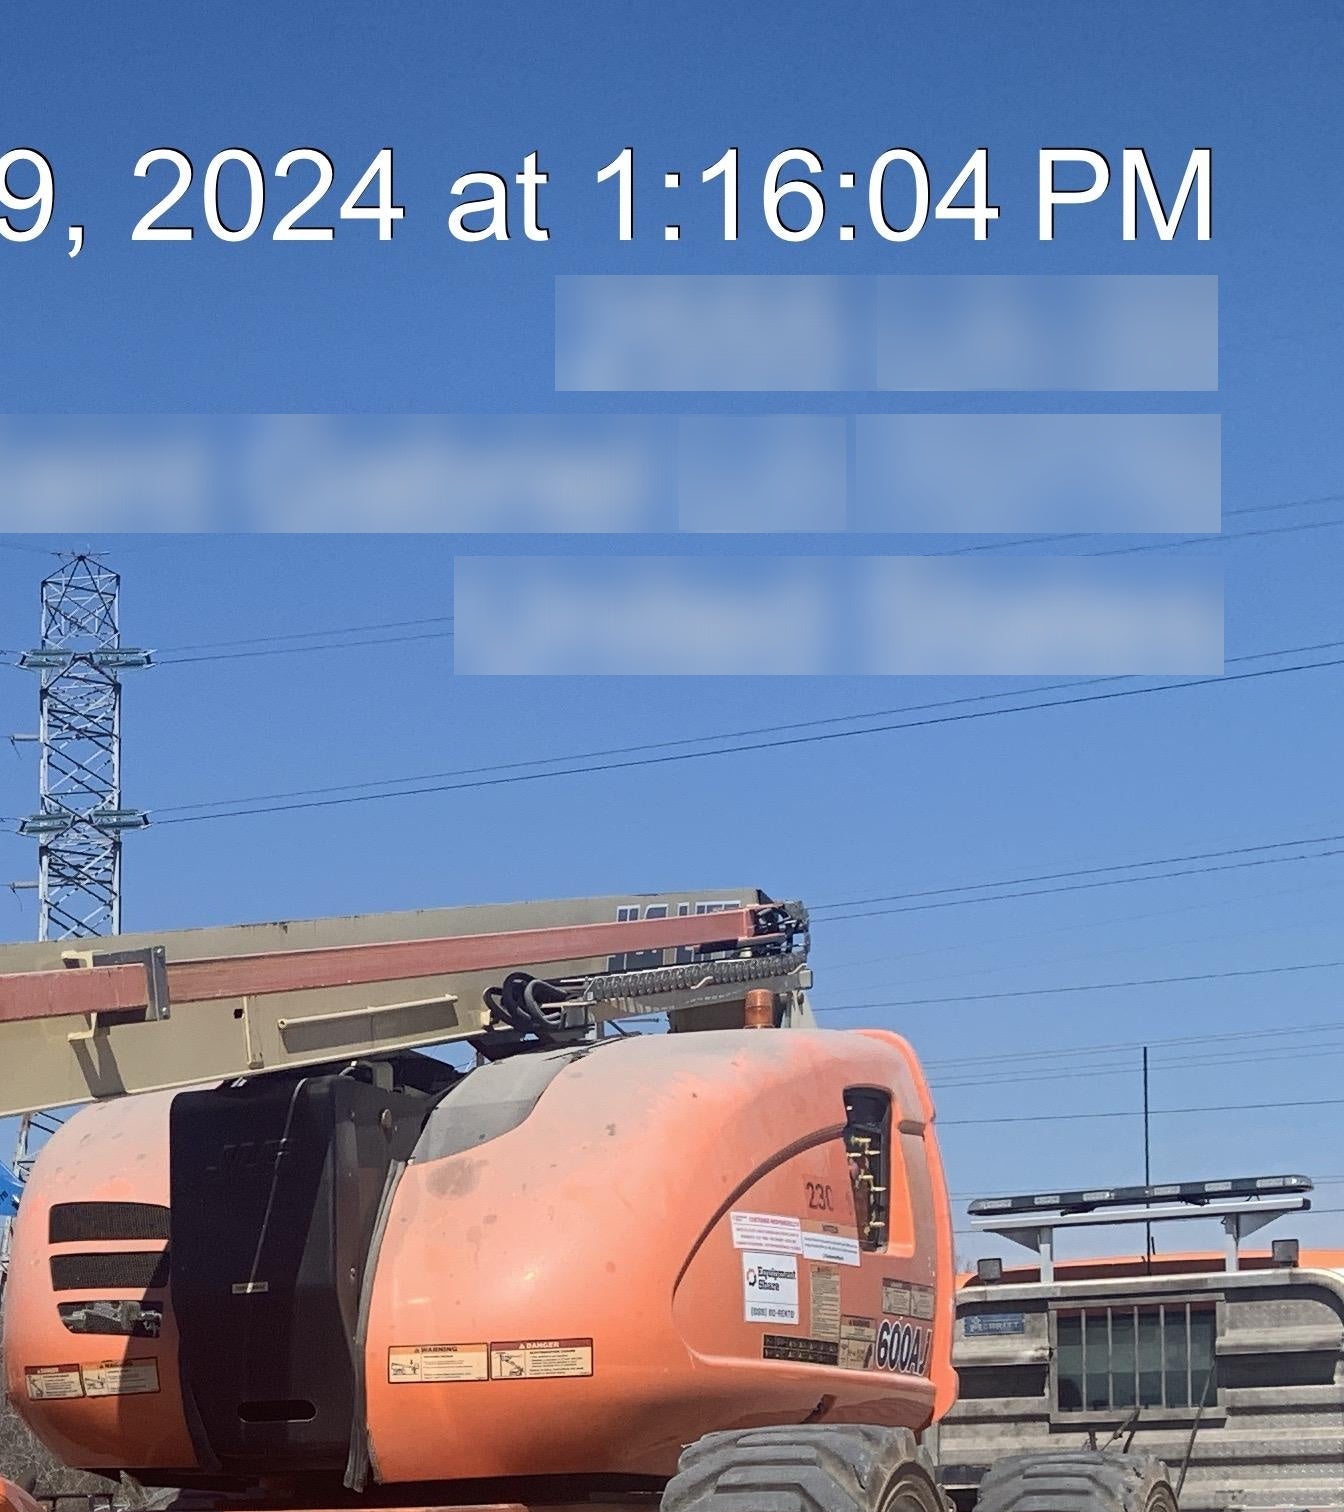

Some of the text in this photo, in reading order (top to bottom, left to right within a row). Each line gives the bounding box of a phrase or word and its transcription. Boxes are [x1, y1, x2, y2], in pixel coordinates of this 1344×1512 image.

[757, 1265, 797, 1281] Equipment
[758, 1279, 780, 1291] Share
[876, 1318, 933, 1377] 600AJ
